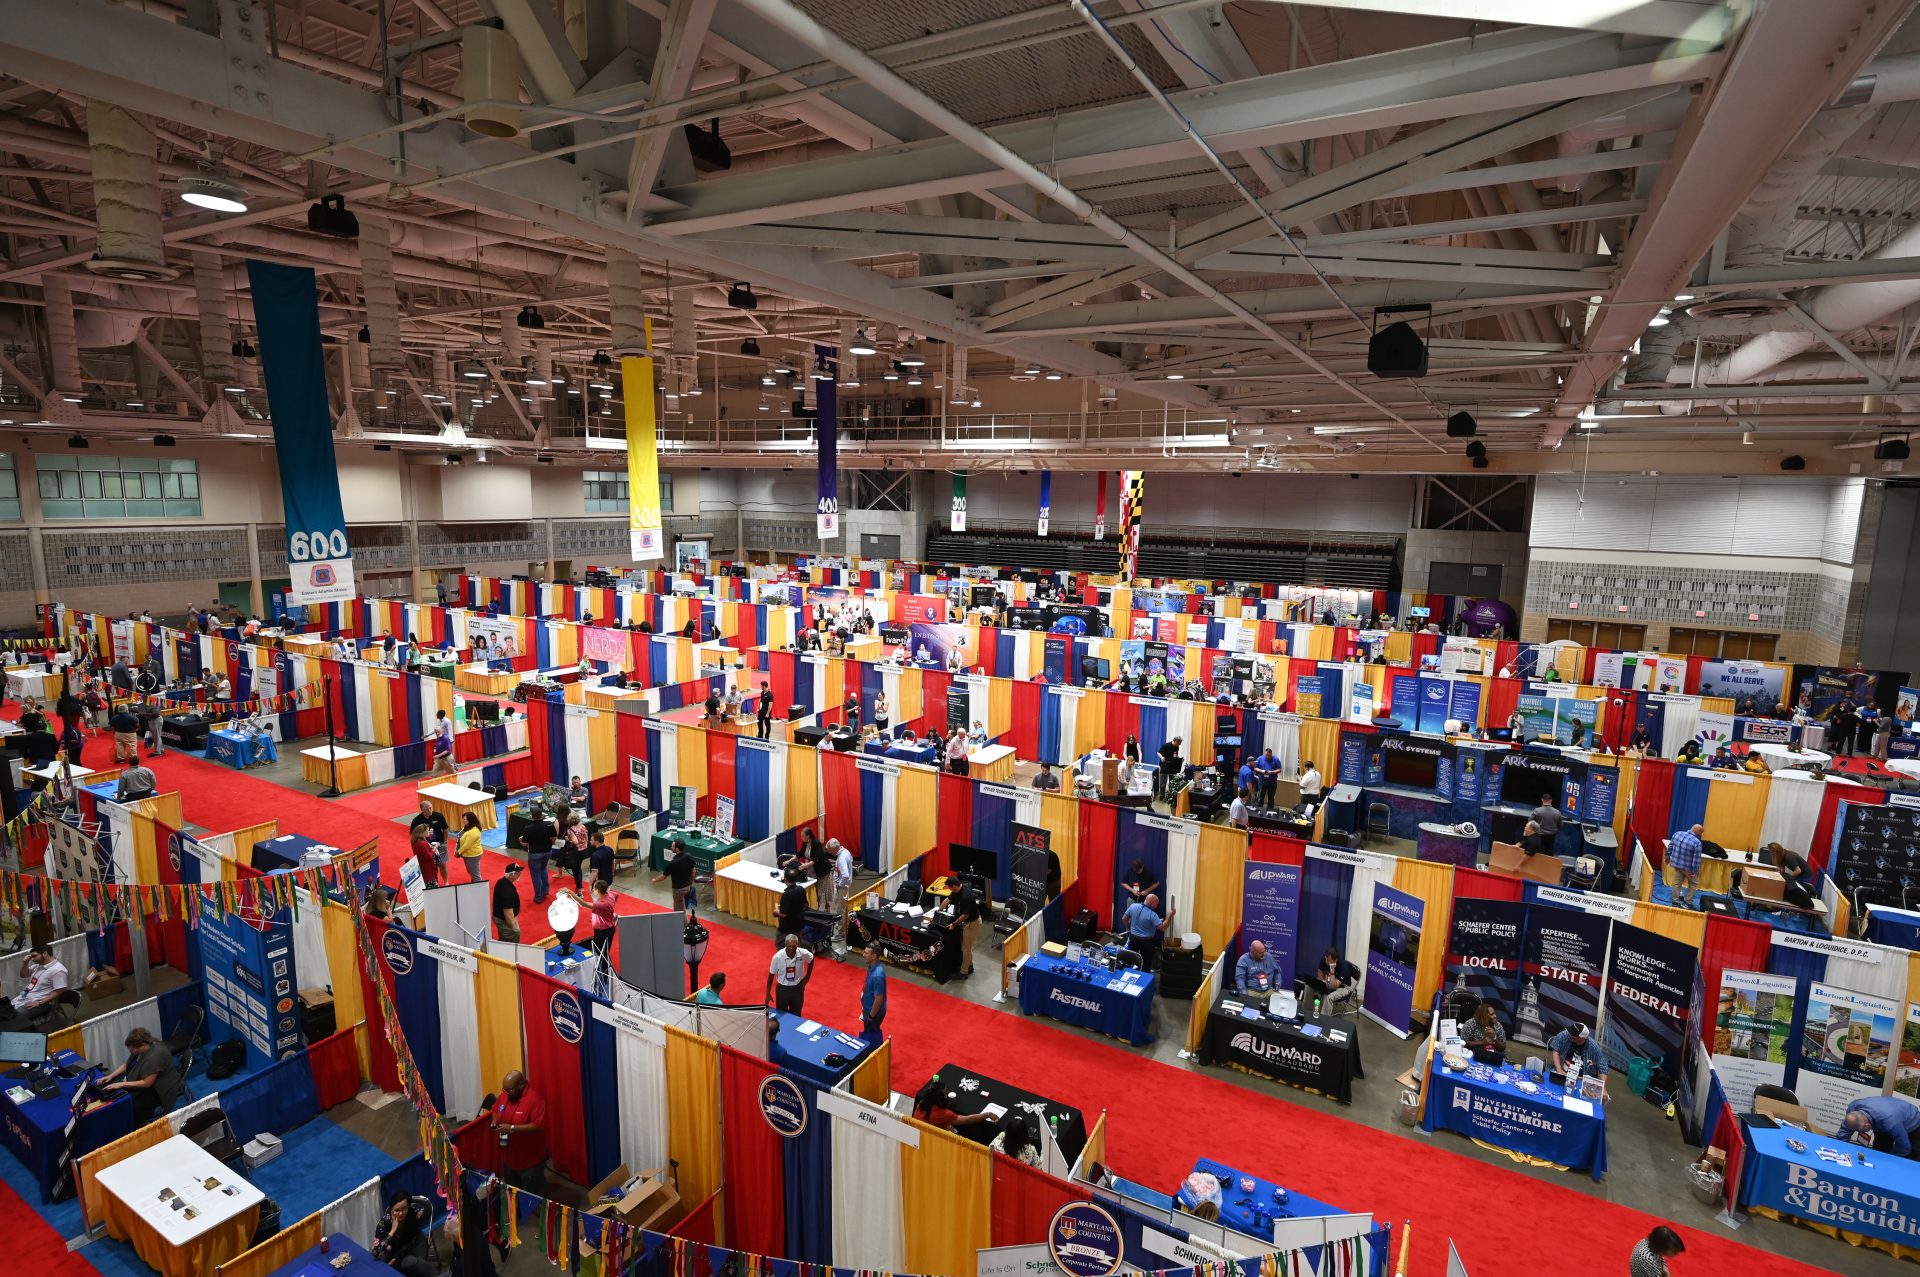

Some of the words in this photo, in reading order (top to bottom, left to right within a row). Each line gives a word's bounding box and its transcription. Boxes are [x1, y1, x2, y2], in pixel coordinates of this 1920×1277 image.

[818, 497, 838, 513] 400
[953, 496, 966, 511] 300
[291, 529, 348, 561] 600
[584, 636, 626, 656] NERDS
[1721, 674, 1731, 683] WE
[1732, 675, 1743, 684] ALL
[1744, 676, 1765, 686] SERVE
[1428, 687, 1445, 695] CMS
[1521, 698, 1542, 706] BIOFUELS
[1753, 724, 1789, 737] ESGR
[1381, 739, 1405, 751] ARK
[1405, 746, 1442, 756] SYSTEMS
[1501, 755, 1529, 768] ARK
[1529, 763, 1570, 774] SYSTEMS
[1015, 792, 1030, 800] SERVICES
[1149, 818, 1166, 827] FASTENAL
[1166, 822, 1184, 830] COMPANY
[1016, 831, 1045, 849] ATS
[1320, 850, 1338, 859] UPWARD
[1338, 852, 1366, 864] BROADBAND
[1260, 870, 1297, 880] UPWARD
[1016, 883, 1039, 894] PARTNER
[1017, 889, 1039, 900] PLATINUM
[1541, 889, 1564, 899] SCHAEFER
[1564, 895, 1582, 903] CENTER
[1592, 901, 1609, 909] PUBLIC
[1608, 904, 1626, 912] POLICY
[1387, 901, 1420, 918] UPWARD
[879, 919, 912, 945] ATS
[1458, 921, 1491, 929] SCHAEFER
[1492, 923, 1517, 931] CENTER
[1465, 927, 1489, 935] PUBLIC
[1491, 930, 1516, 938] POLICY
[1541, 928, 1579, 941] EXPERTISE
[428, 945, 445, 957] STANDARD
[1784, 936, 1809, 946] BARTON
[1815, 942, 1849, 955] LOGUIDICE,
[1850, 949, 1869, 958] D.P.C.
[1463, 955, 1507, 970] LOCAL
[1618, 947, 1667, 969] KNOWLEDGE
[1618, 953, 1646, 968] WORKS
[1379, 960, 1397, 974] LOCAL
[1397, 970, 1403, 978] &
[1540, 965, 1588, 985] STATE
[1617, 960, 1660, 980] Government
[1368, 963, 1413, 991] FAMILY-OWNED
[1624, 968, 1654, 984] Nonprofit
[1655, 981, 1684, 996] Agencies
[1050, 988, 1101, 1013] FASTENAL
[1613, 982, 1681, 1019] FEDERAL
[1728, 1018, 1777, 1031] ENVIRONMENTAL
[1251, 1036, 1322, 1066] UPWARD
[1271, 1055, 1320, 1071] BROADBAND
[1818, 1062, 1849, 1074] Experience
[1856, 1071, 1875, 1080] Listen.
[1851, 1074, 1867, 1083] Solve.
[1832, 1081, 1861, 1093] Management
[776, 1090, 800, 1102] MARYLAND
[776, 1096, 798, 1109] COUNTIES
[772, 1107, 793, 1118] BRONZE
[1474, 1095, 1528, 1115] UNIVERSITY
[1531, 1110, 1544, 1118] OF
[858, 1111, 877, 1125] AETNA
[1472, 1114, 1500, 1126] Schaefer
[1501, 1121, 1524, 1134] Center
[1525, 1128, 1535, 1136] for
[1473, 1102, 1563, 1134] BALTIMORE
[1472, 1119, 1492, 1130] Public
[1492, 1124, 1512, 1136] Policy
[1785, 1162, 1900, 1213] Barton
[1784, 1187, 1920, 1236] &Loguidi
[1077, 1219, 1117, 1234] MARYLAND
[1078, 1229, 1112, 1243] COUNTIES
[1070, 1245, 1101, 1258] BRONZE
[981, 1267, 995, 1275] Life
[1062, 1257, 1088, 1268] Corporate
[1088, 1263, 1108, 1272] Partner
